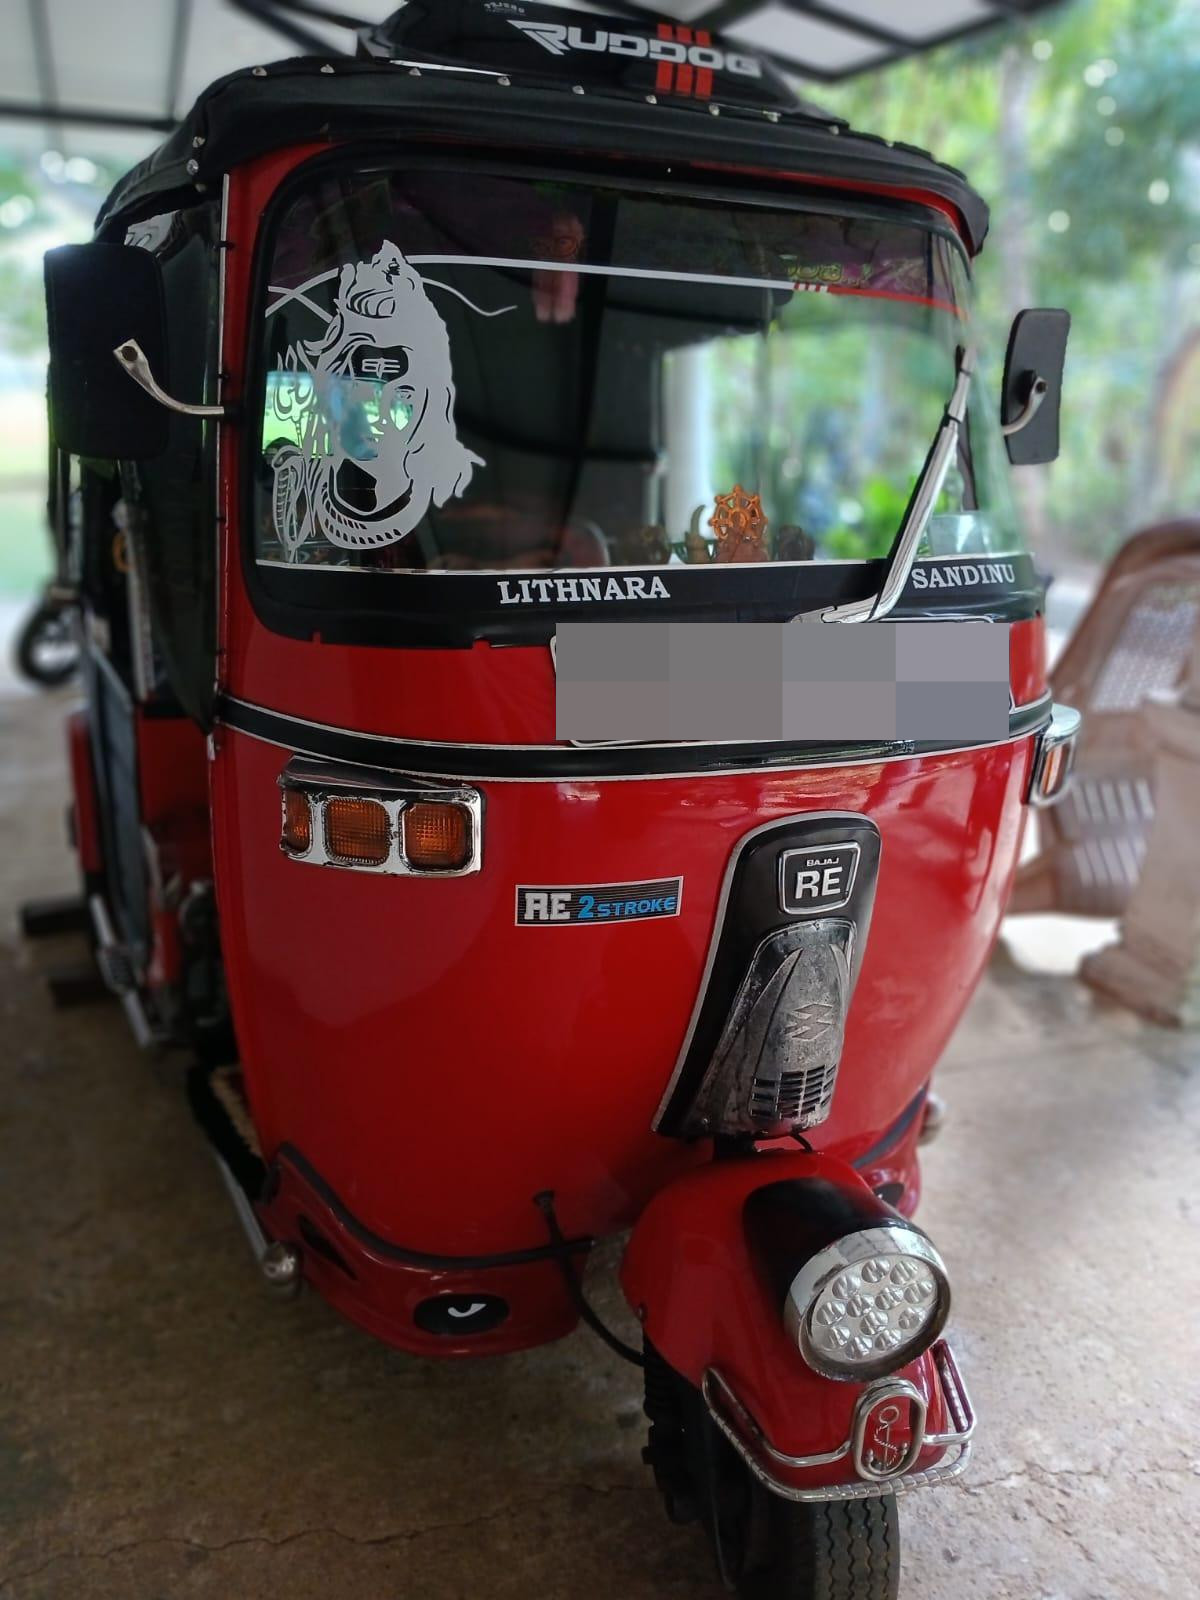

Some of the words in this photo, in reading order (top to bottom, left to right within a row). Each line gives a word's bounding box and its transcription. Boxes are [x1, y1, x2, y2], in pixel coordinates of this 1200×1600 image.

[506, 19, 763, 78] RUDDOG
[497, 575, 671, 604] LITHNARA
[911, 563, 1016, 589] SANDINU
[806, 857, 840, 867] BAJAJ
[795, 866, 843, 899] RE
[524, 892, 572, 920] RE
